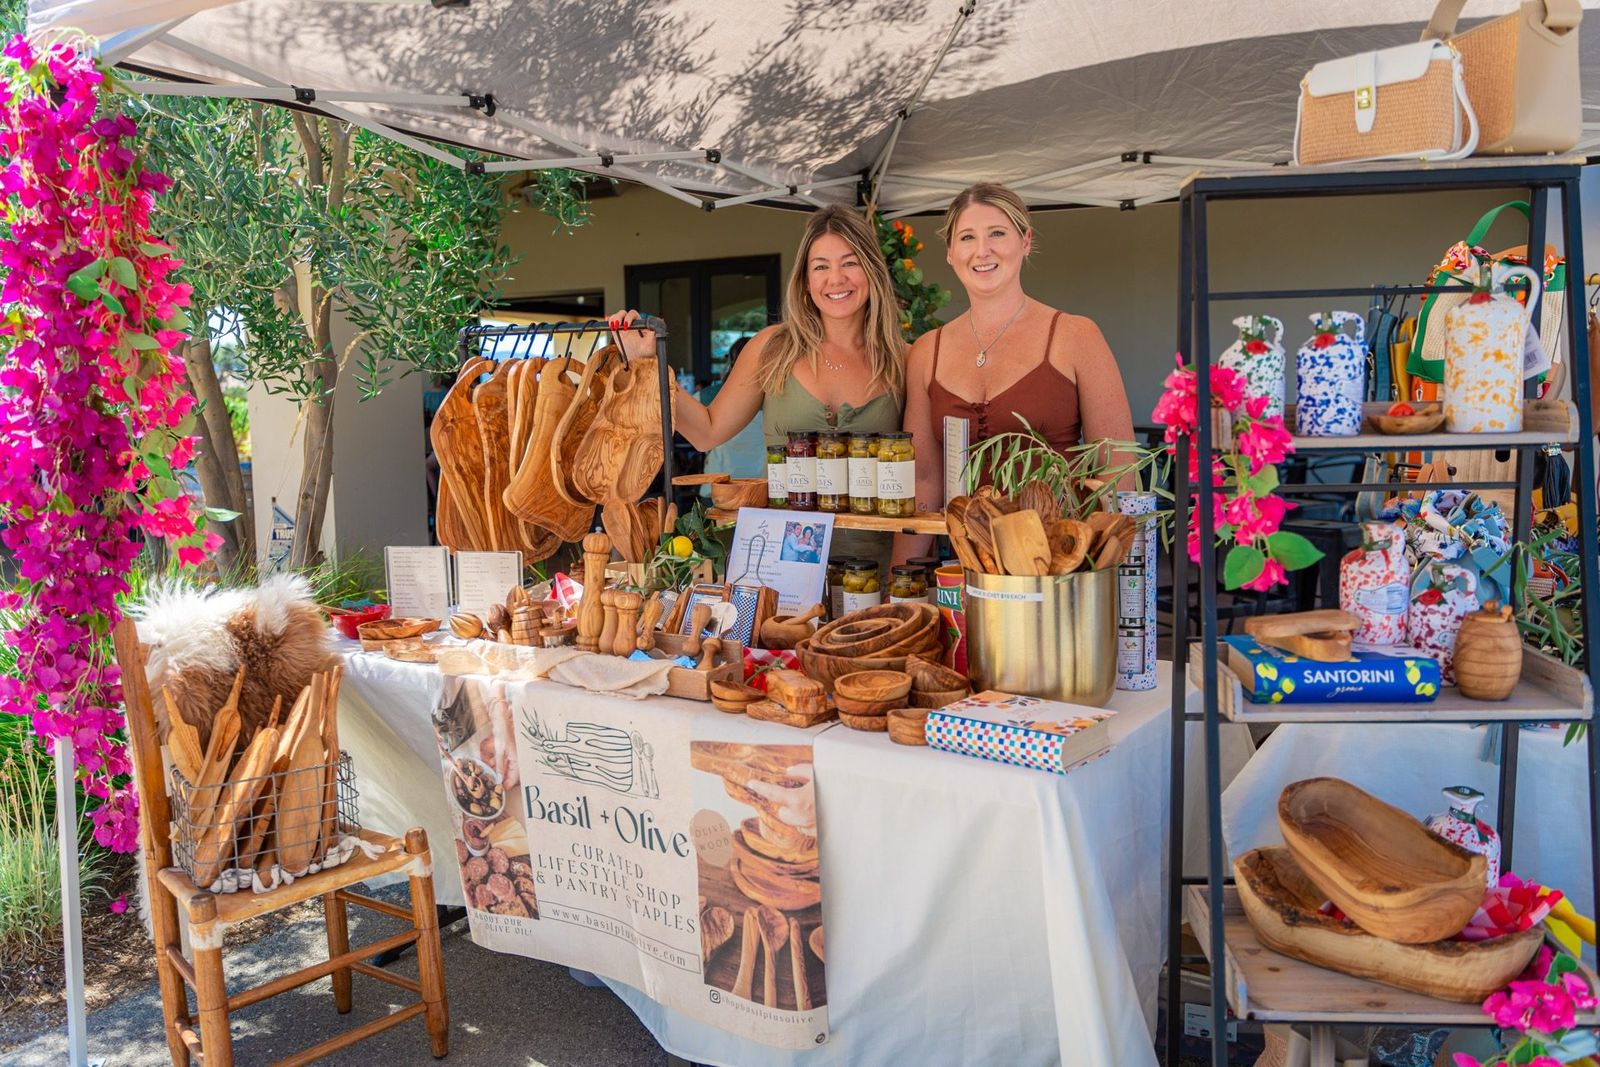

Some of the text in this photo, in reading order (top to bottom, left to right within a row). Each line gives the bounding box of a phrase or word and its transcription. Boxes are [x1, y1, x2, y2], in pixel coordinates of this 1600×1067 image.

[1303, 669, 1395, 684] SANTORINI
[524, 784, 690, 858] Basil + Olive
[538, 854, 681, 910] LIFESTYLE SHOP
[571, 842, 644, 879] CURATED
[503, 918, 522, 926] OUR
[536, 871, 696, 934] & PANTRY STAPLES
[485, 923, 511, 934] OLIVE
[551, 907, 687, 967] www.basilplusolive.com
